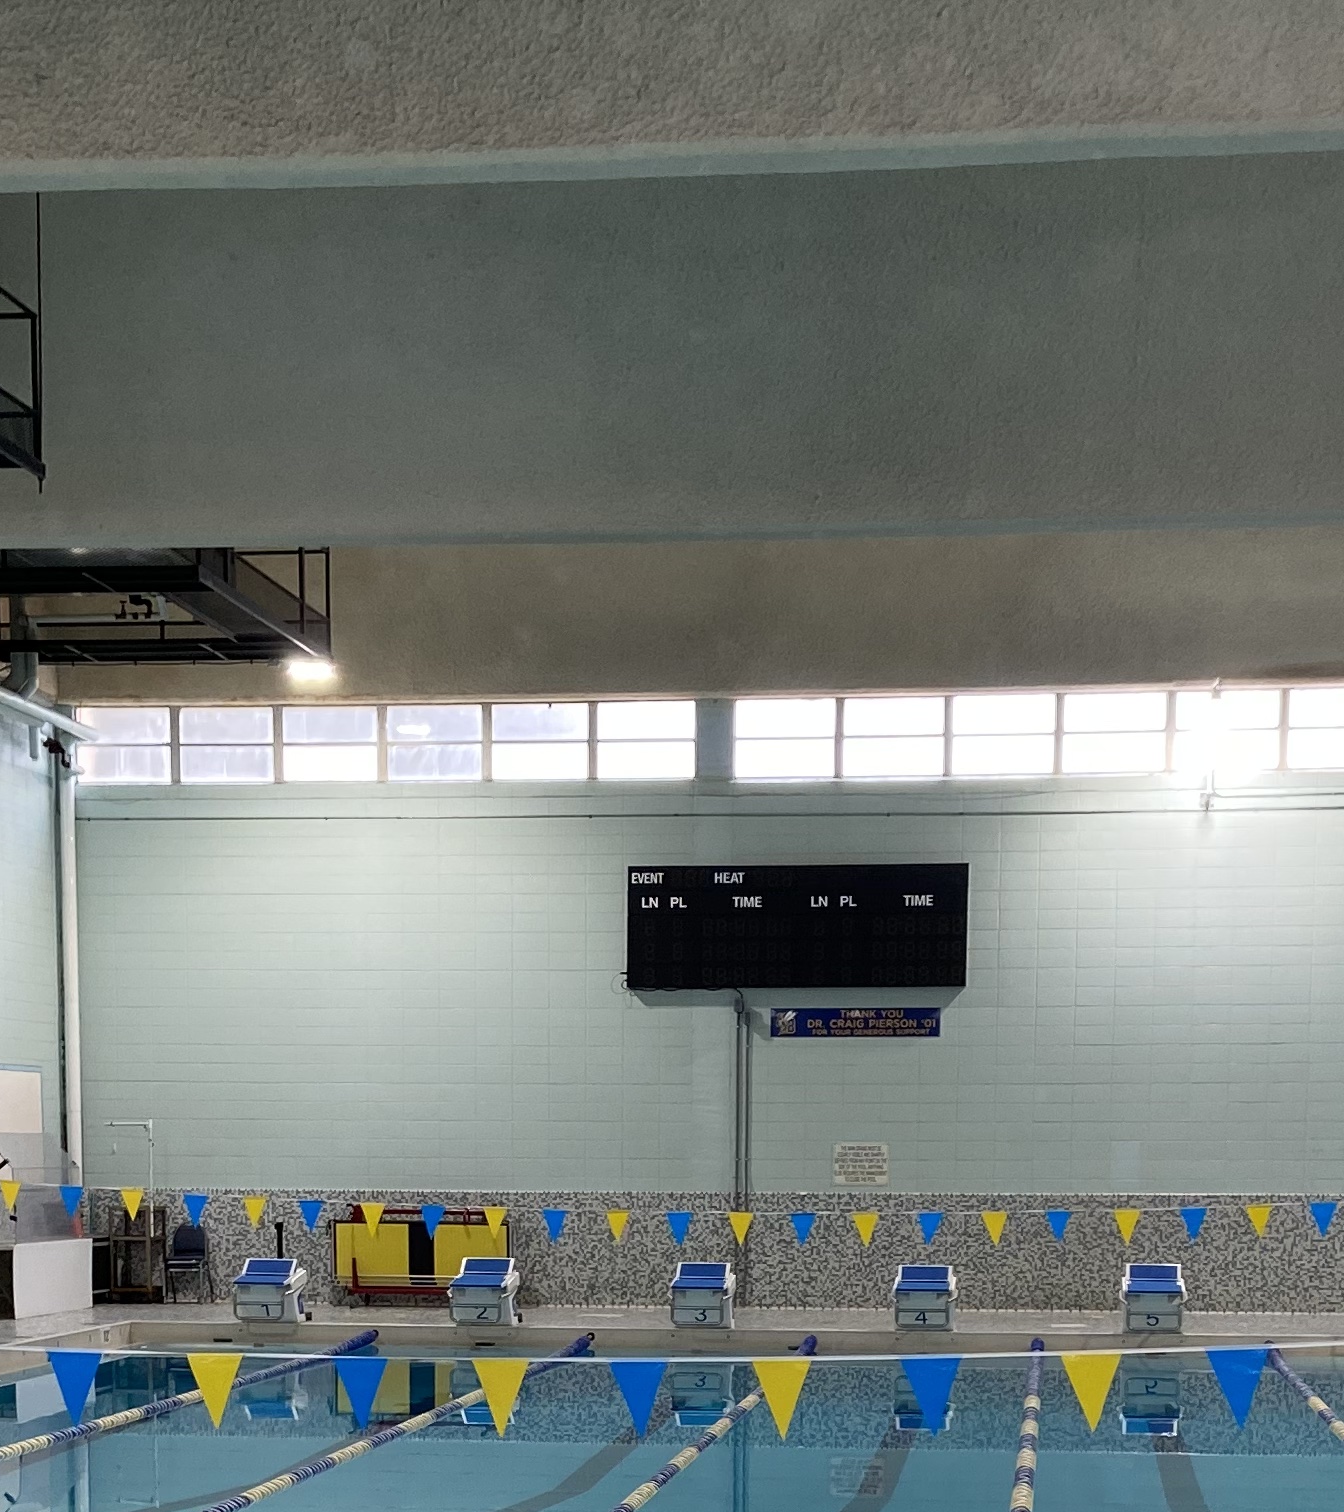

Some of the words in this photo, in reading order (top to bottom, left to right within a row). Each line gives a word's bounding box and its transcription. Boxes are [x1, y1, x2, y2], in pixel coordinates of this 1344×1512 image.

[631, 872, 664, 885] EVENT
[713, 872, 745, 884] HEAT
[641, 897, 659, 909] LN
[670, 897, 688, 909] PL
[732, 896, 763, 908] TIME
[810, 896, 828, 908] LN
[839, 896, 858, 908] PL
[903, 894, 934, 907] TIME
[840, 1009, 877, 1019] THANK
[882, 1009, 904, 1018] YOU
[807, 1019, 825, 1029] DR.
[829, 1019, 865, 1029] CRAIG
[868, 1019, 918, 1028] PIERSON
[476, 1306, 489, 1319] 2
[695, 1308, 707, 1322] 3
[914, 1311, 928, 1325] 4
[1146, 1313, 1160, 1327] 5
